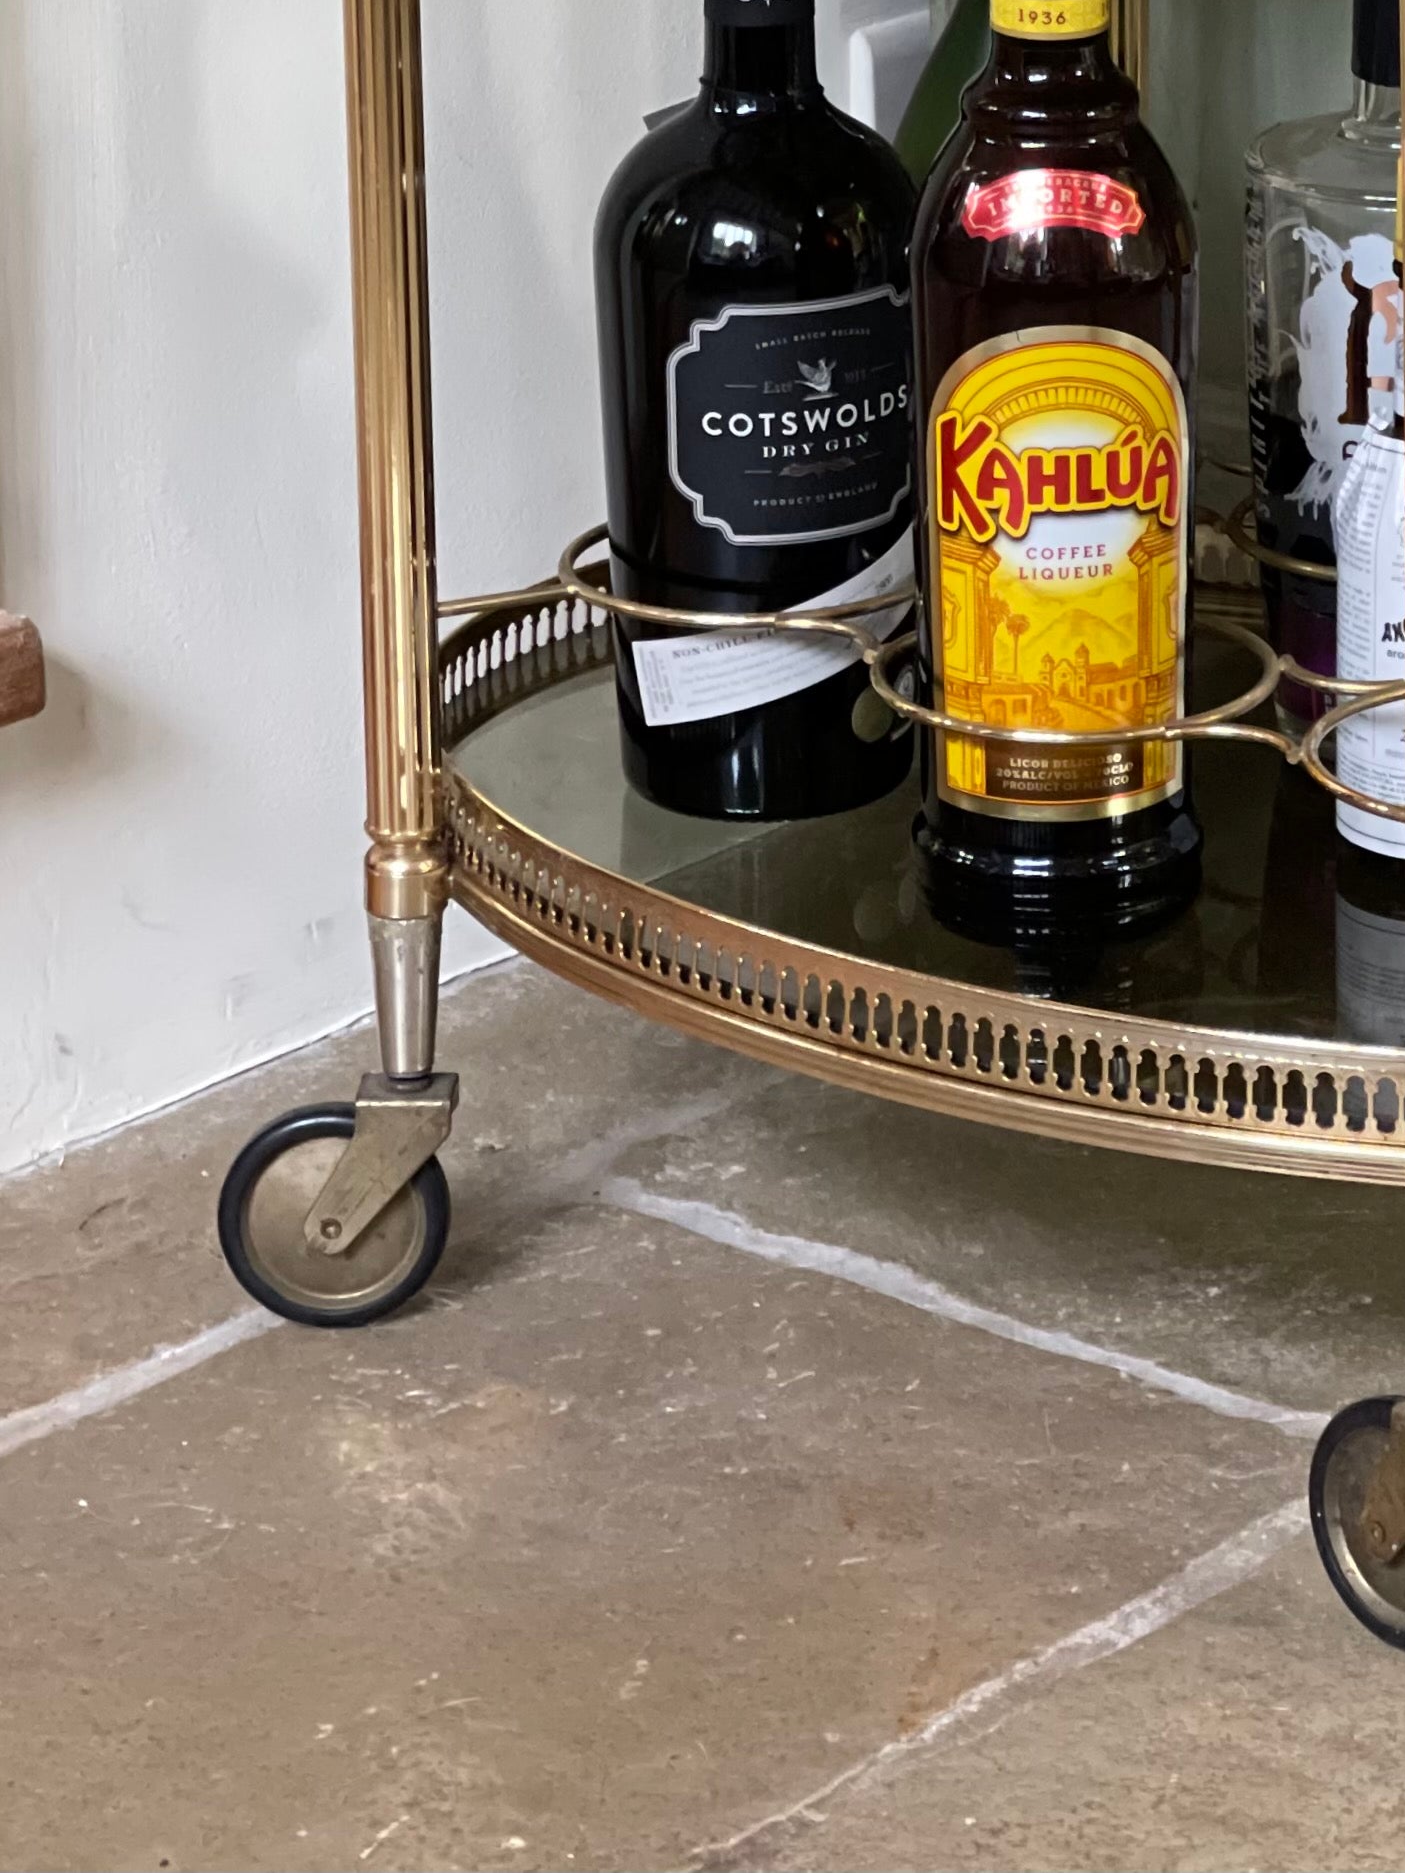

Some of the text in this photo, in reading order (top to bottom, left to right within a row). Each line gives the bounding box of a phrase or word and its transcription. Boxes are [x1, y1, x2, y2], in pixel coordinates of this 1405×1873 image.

[1018, 8, 1066, 25] 1936
[987, 188, 1123, 216] IMORTED
[701, 383, 908, 438] COTSWOLDS
[762, 431, 870, 459] DRY GIN
[938, 414, 1179, 538] KAHLÚA
[1026, 544, 1107, 560] COFFEE
[1019, 563, 1113, 581] LIQUEUR
[1010, 757, 1049, 769] LICOR
[1002, 780, 1059, 792] PRODUCT
